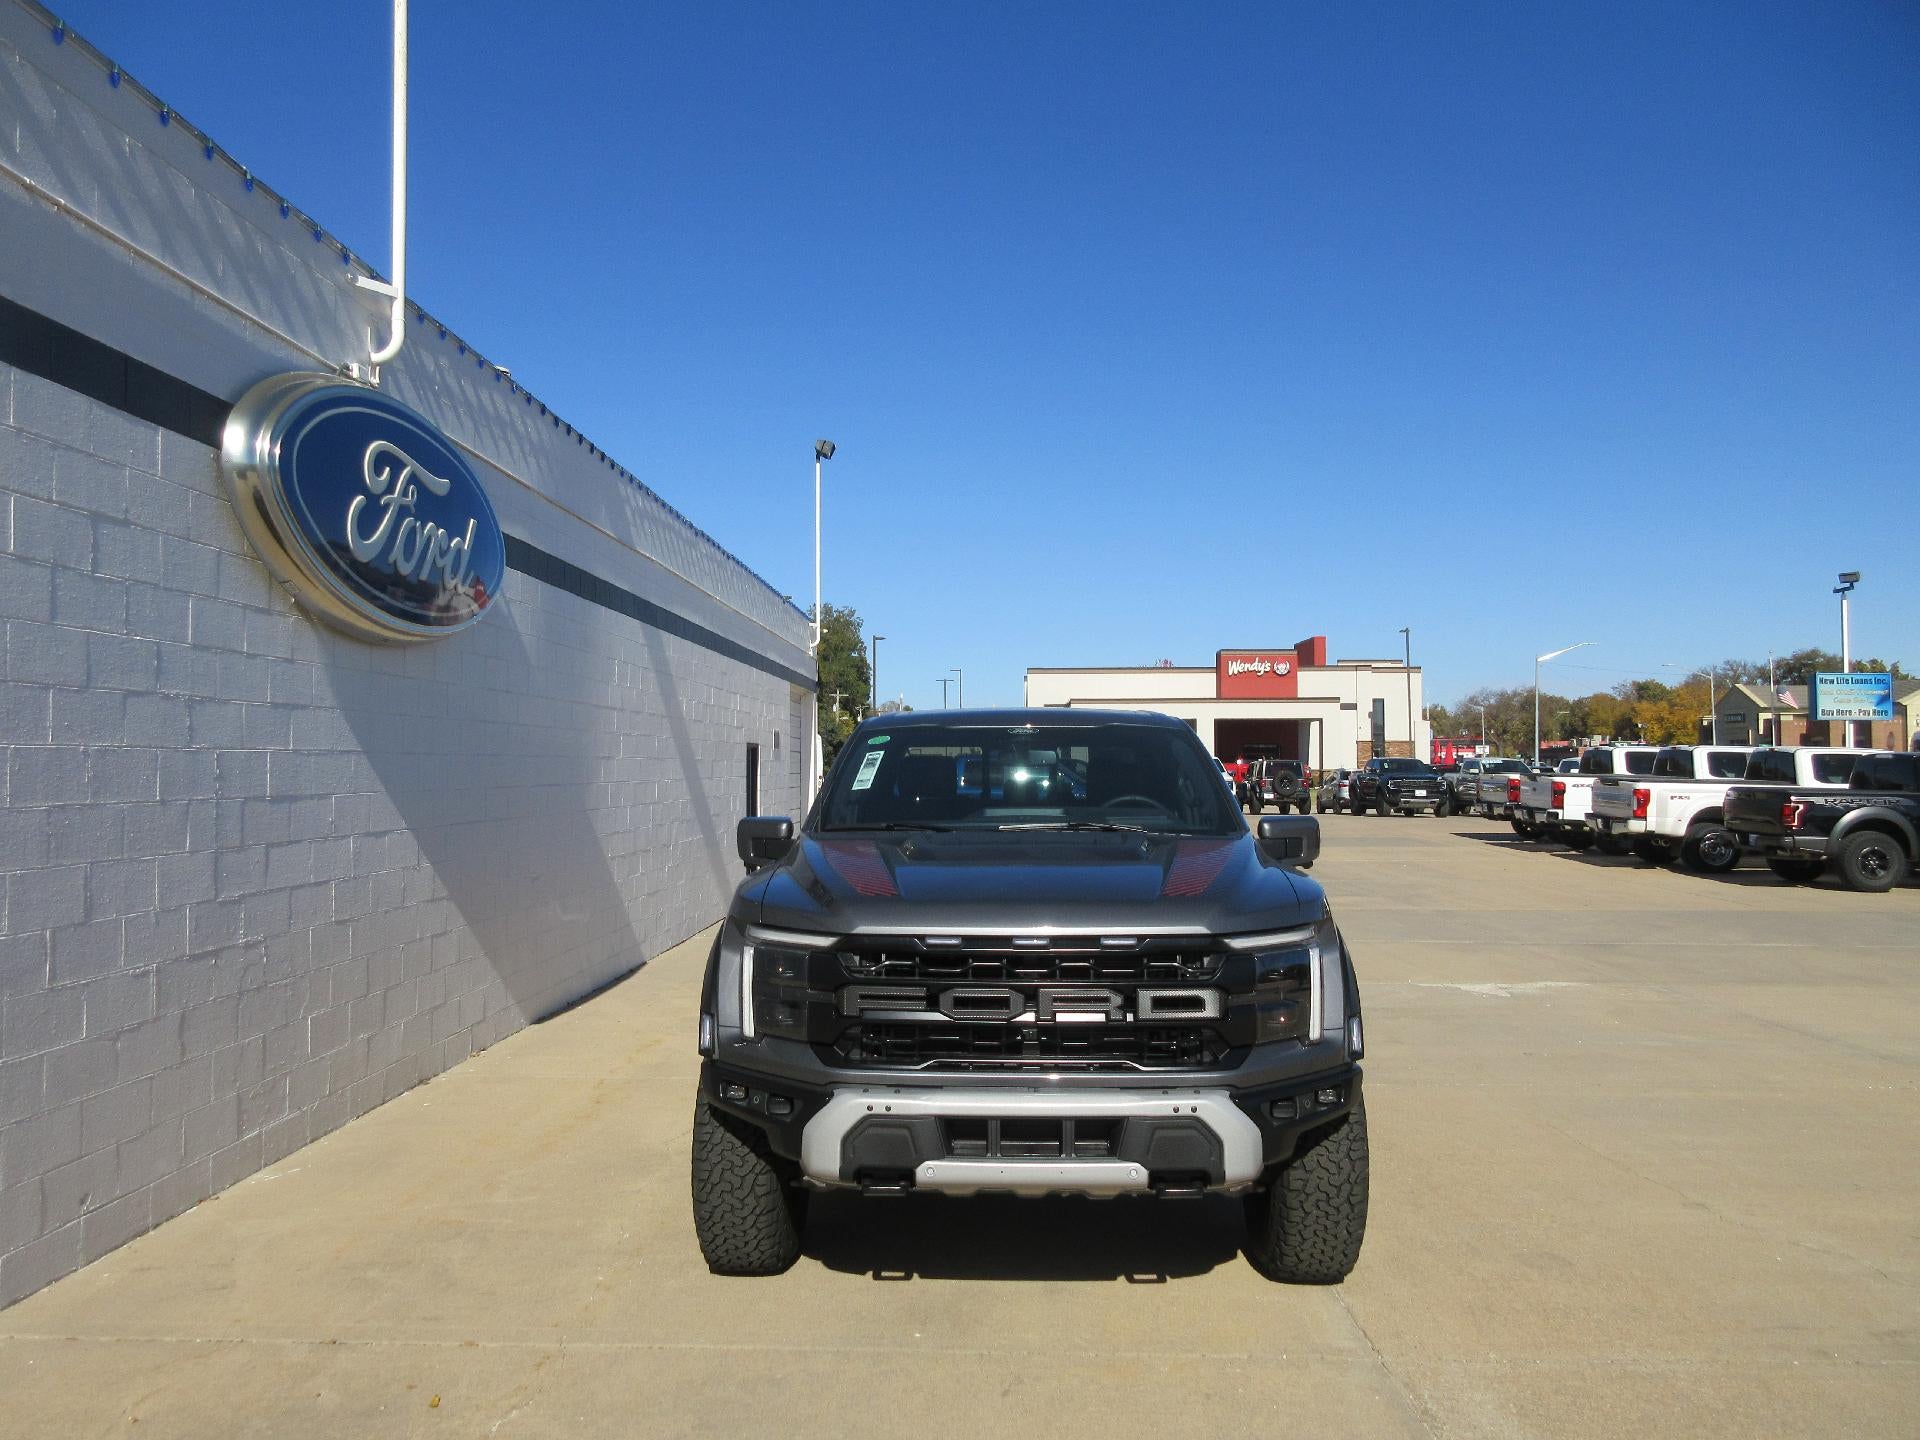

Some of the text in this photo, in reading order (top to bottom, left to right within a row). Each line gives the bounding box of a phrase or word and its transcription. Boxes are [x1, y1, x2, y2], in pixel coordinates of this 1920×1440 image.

[346, 440, 478, 592] Ford
[1228, 657, 1271, 676] Wendy's
[1819, 677, 1835, 685] New
[1851, 677, 1873, 685] Loans
[1821, 709, 1835, 717] Buy
[1858, 709, 1871, 717] Pay
[1872, 709, 1889, 717] Here
[841, 986, 1222, 1022] FORD
